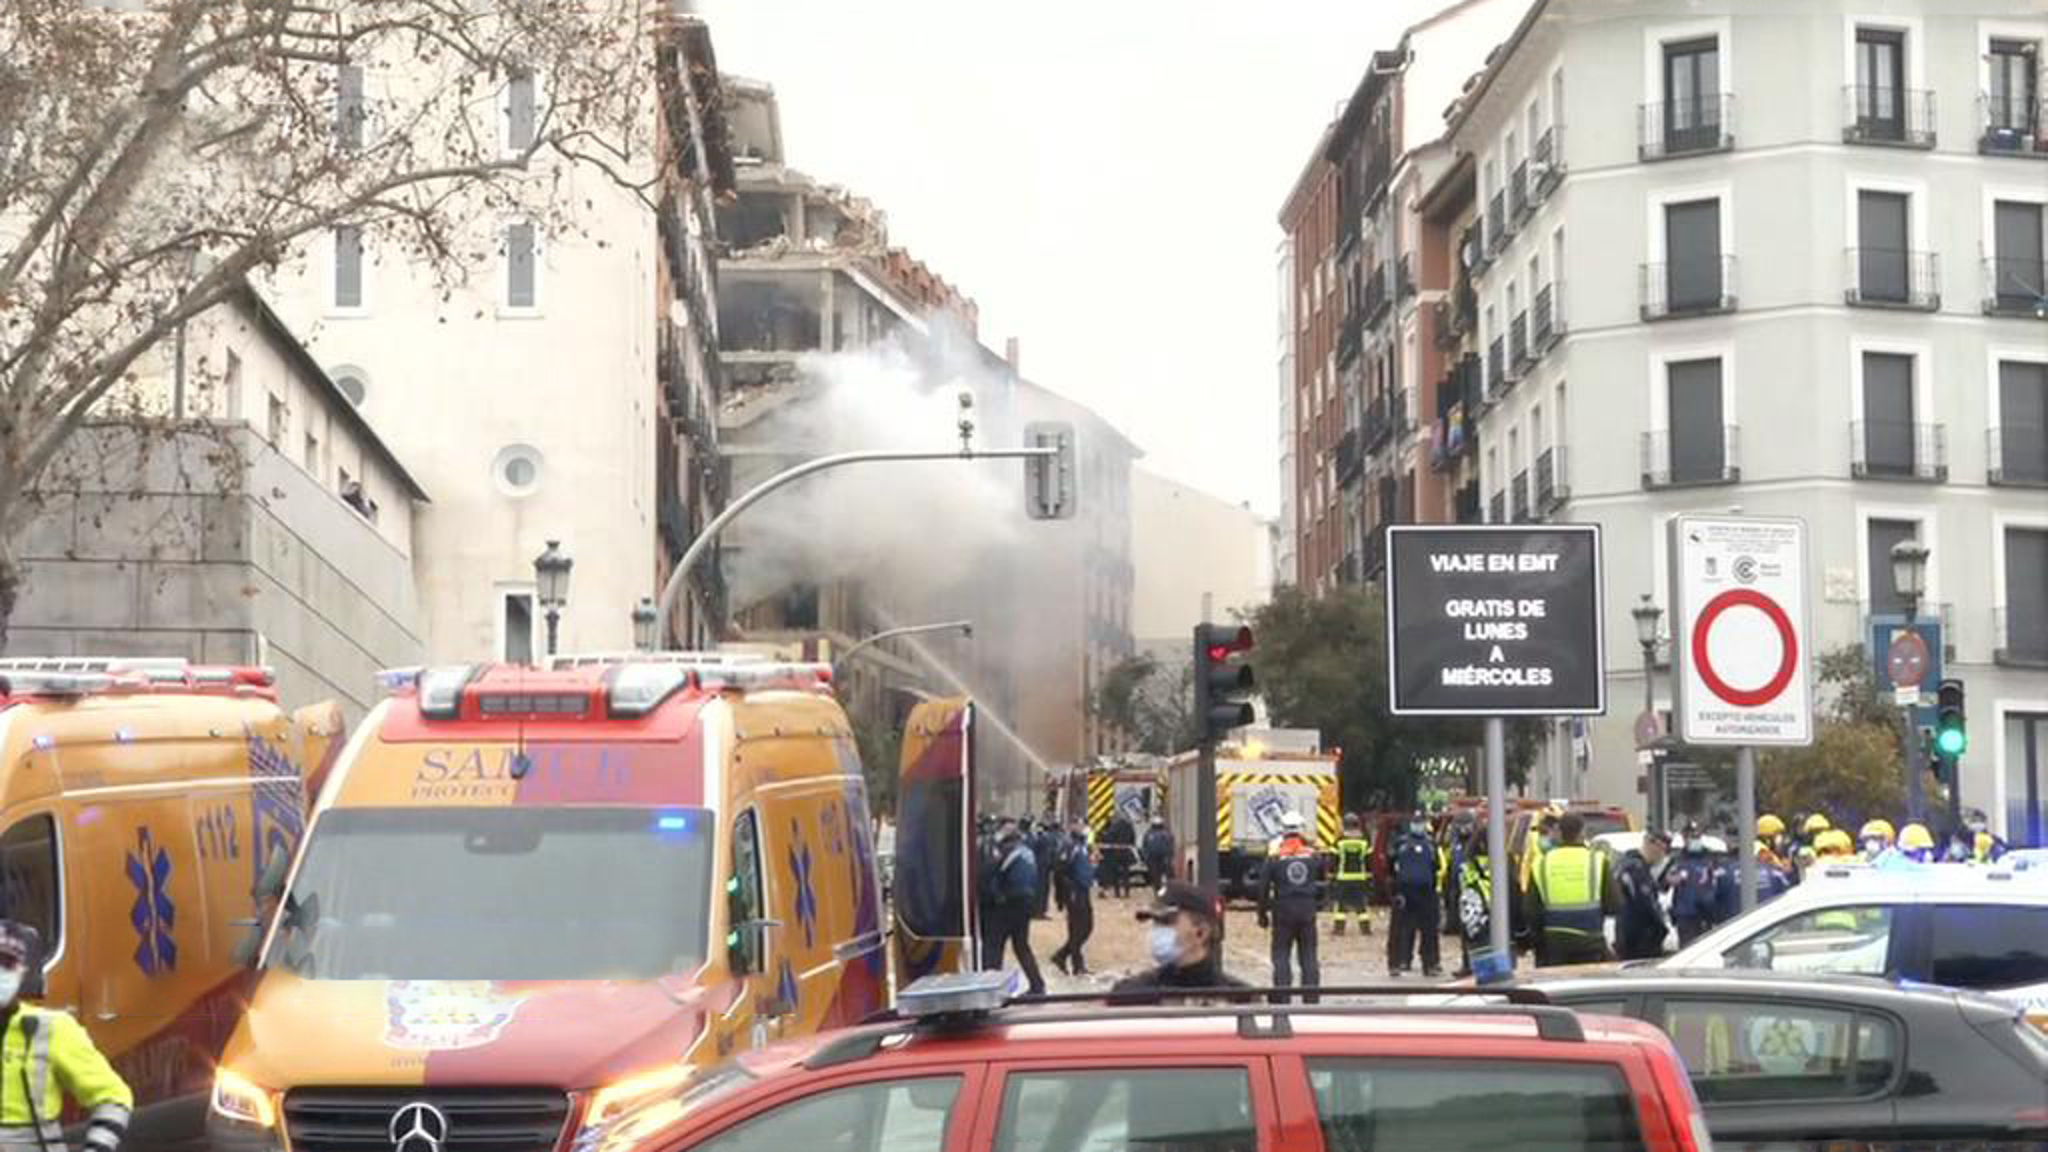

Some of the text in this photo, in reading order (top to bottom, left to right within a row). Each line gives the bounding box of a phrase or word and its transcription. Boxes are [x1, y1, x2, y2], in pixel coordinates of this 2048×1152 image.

[1429, 554, 1559, 572] VIAJE EN EMT
[1445, 599, 1546, 617] GRATIS DE
[1464, 622, 1528, 640] LUNES
[1489, 645, 1505, 662] A
[1441, 664, 1553, 686] MIÉRCOLES
